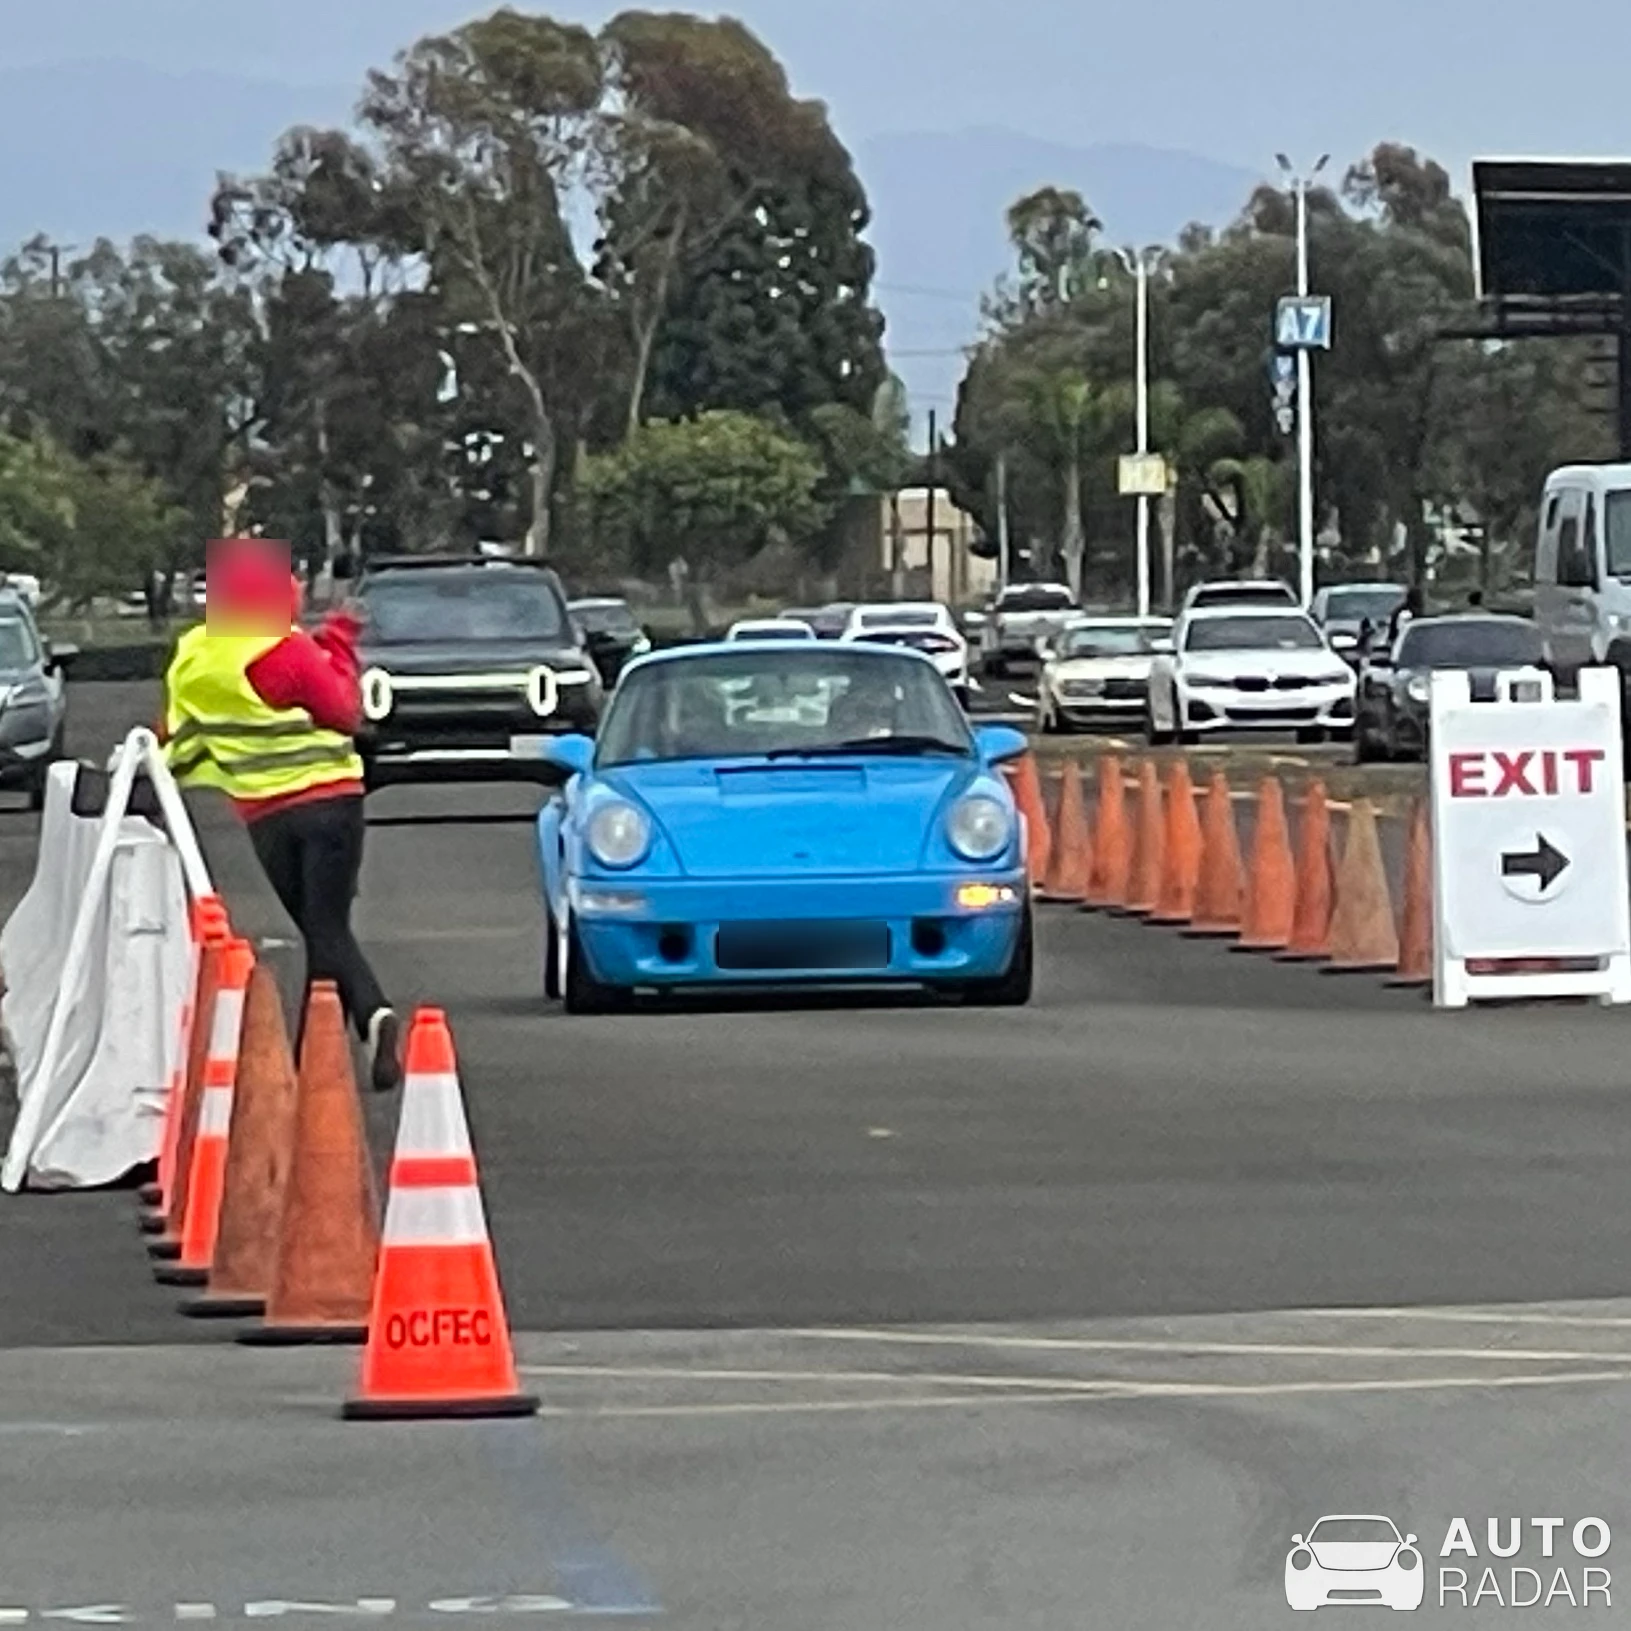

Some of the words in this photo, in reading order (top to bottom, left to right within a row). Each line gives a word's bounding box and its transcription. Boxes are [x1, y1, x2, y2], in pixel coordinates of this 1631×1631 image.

[1277, 306, 1322, 341] A7
[1449, 750, 1605, 797] EXIT
[386, 1310, 491, 1348] OCFEC
